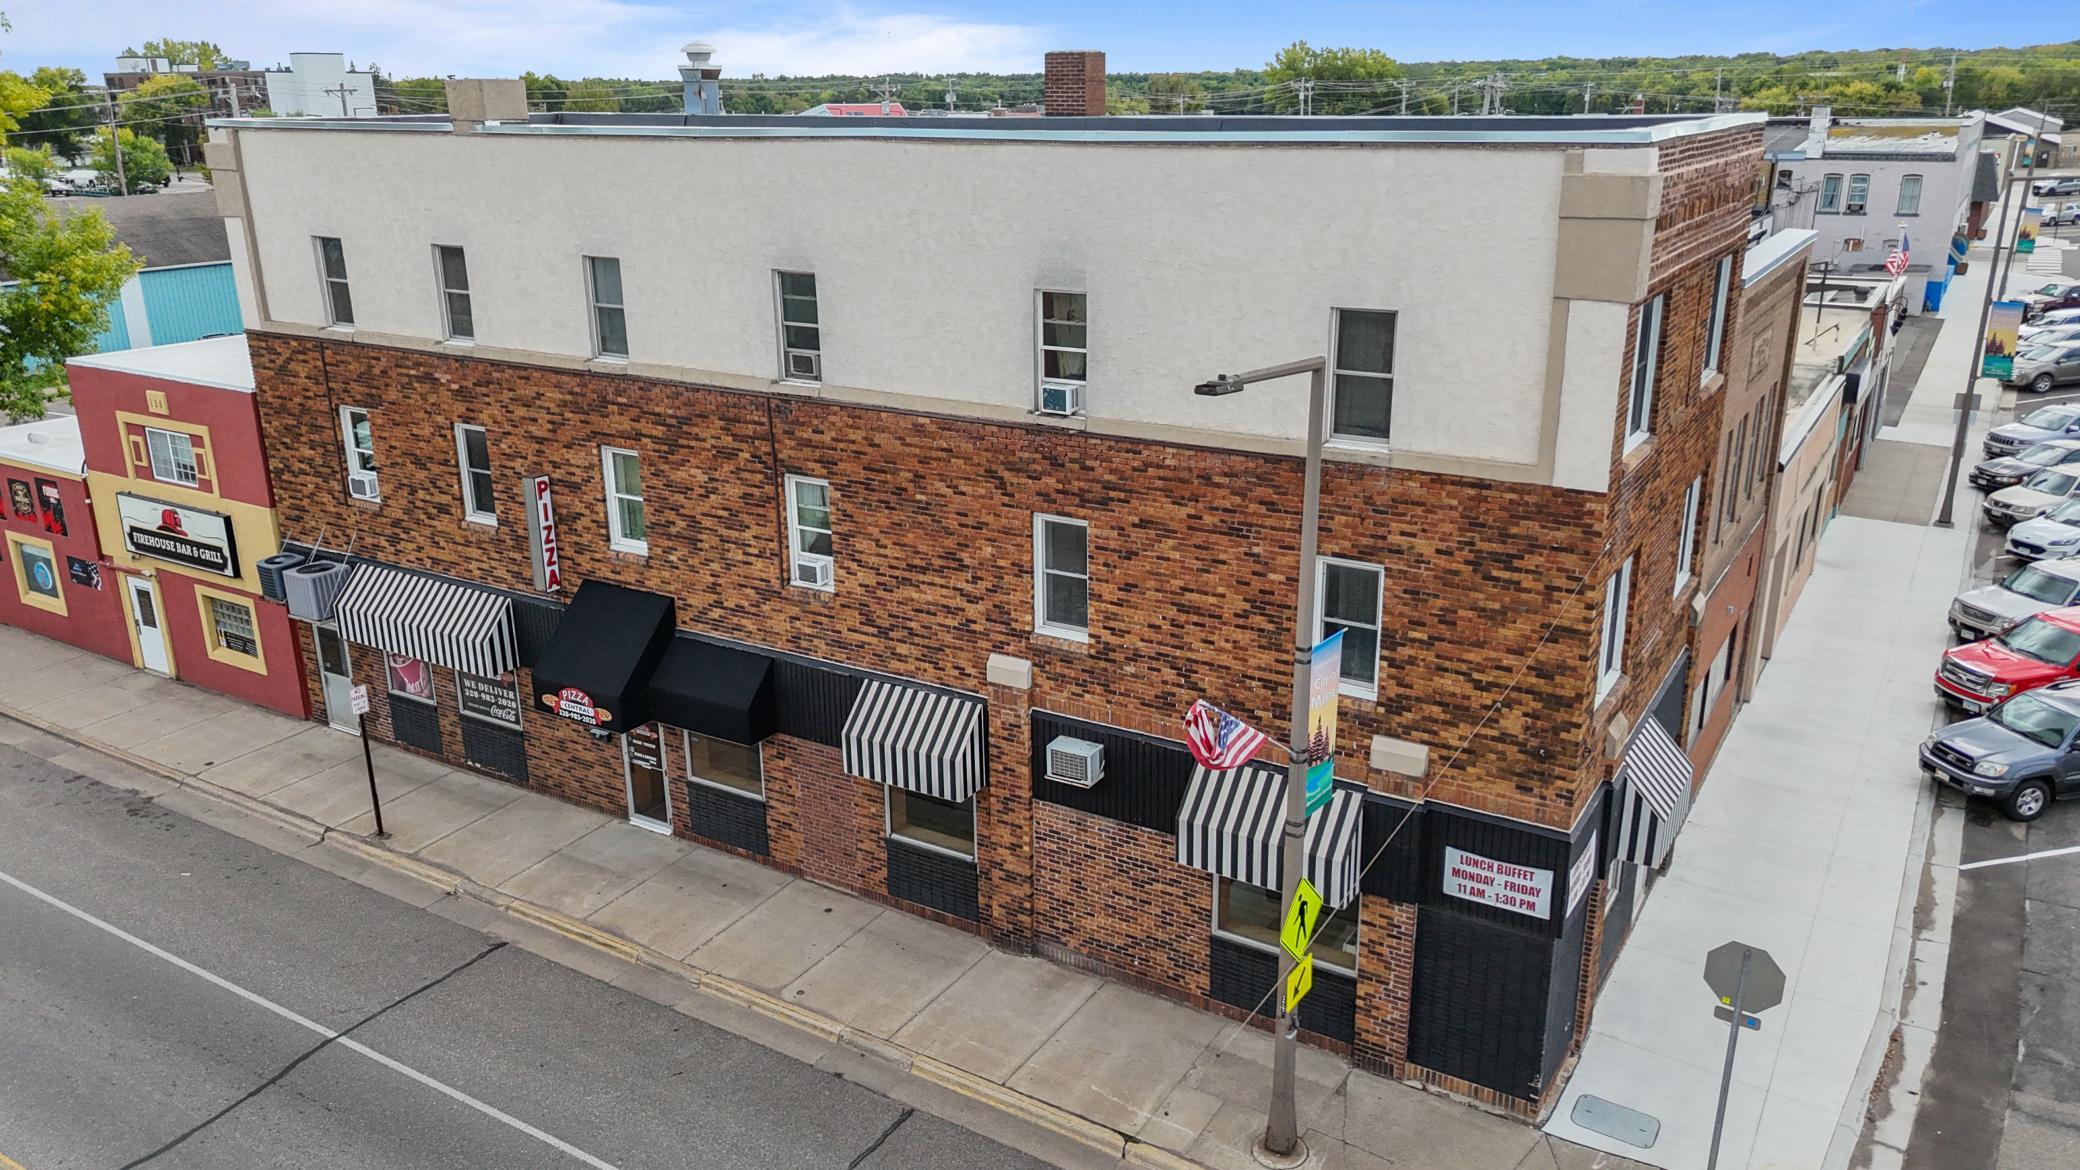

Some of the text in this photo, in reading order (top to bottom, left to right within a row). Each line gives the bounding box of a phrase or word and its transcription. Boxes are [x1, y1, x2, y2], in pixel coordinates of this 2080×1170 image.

[132, 532, 223, 564] FIREHOUSE BAR & GRILL
[536, 480, 560, 590] PIZZA
[464, 679, 515, 699] WE DELIVER
[464, 688, 517, 708] 320-983-2020
[562, 690, 589, 706] PIZZA
[564, 703, 590, 715] CENTRAL
[1460, 854, 1535, 882] LUNCH BUFFET
[1451, 867, 1496, 887] MONDAY
[1504, 880, 1542, 898] FRIDAY
[1457, 883, 1467, 895] 11
[1469, 886, 1486, 899] AM
[1494, 893, 1516, 907] 1:30
[1519, 899, 1536, 912] PM
